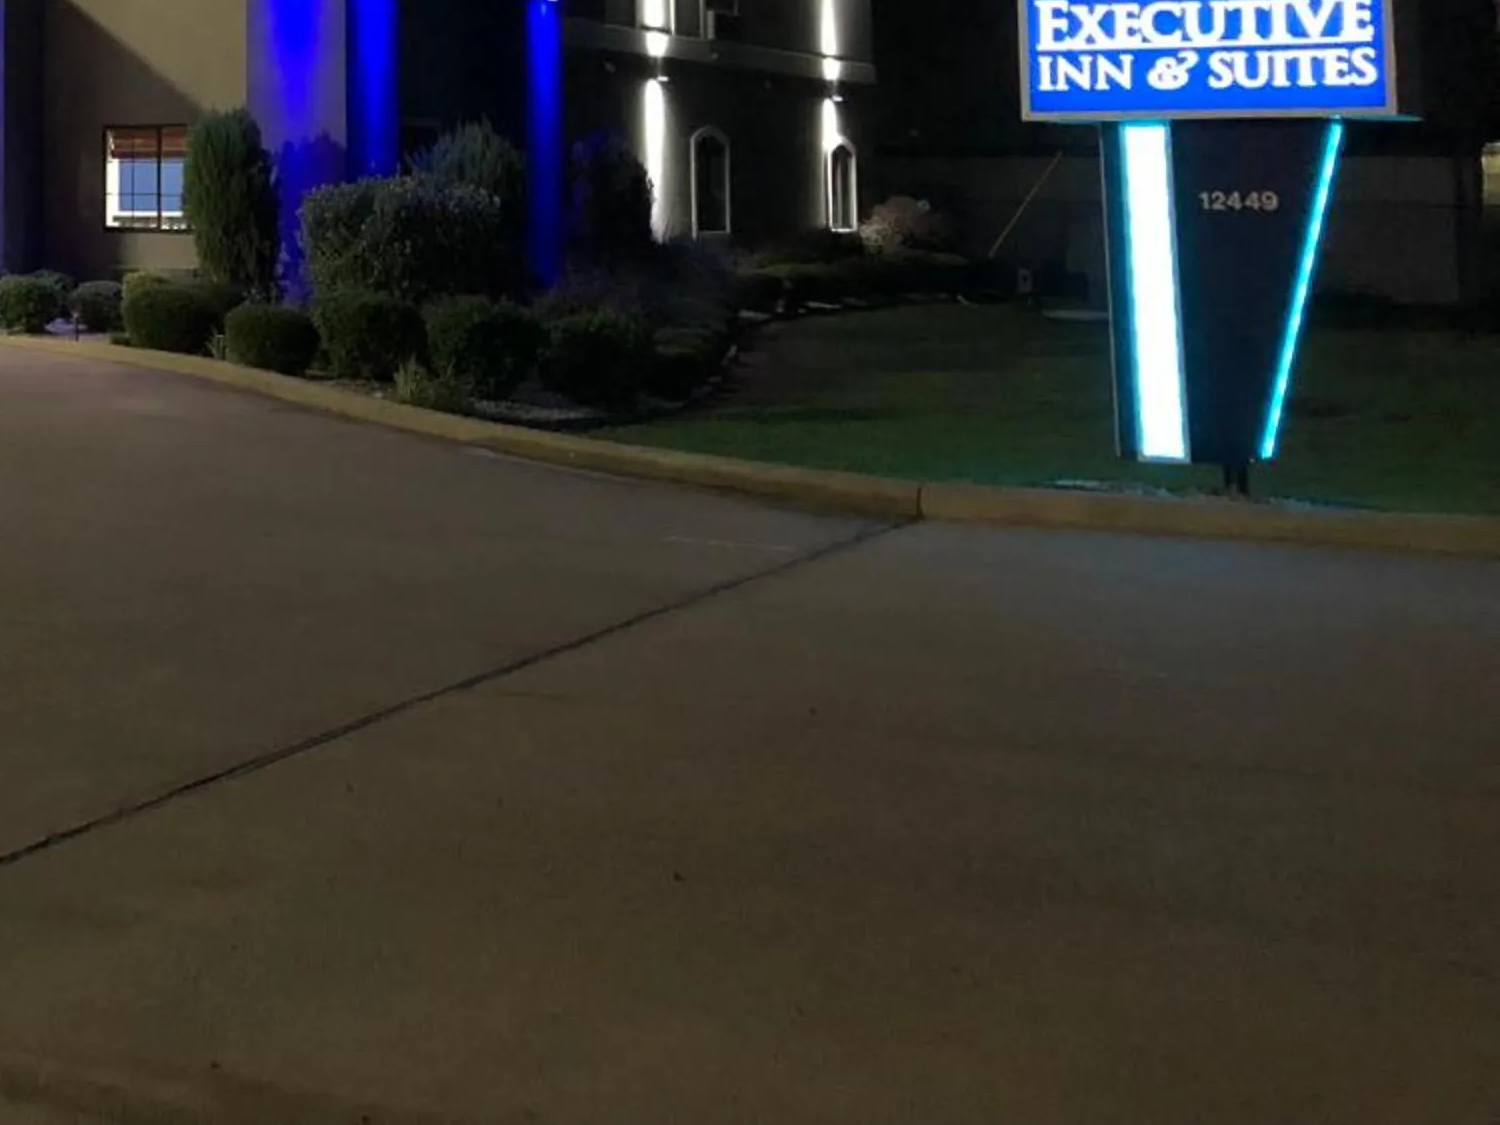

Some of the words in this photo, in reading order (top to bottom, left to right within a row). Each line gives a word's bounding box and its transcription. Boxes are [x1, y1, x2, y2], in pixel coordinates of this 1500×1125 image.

[1038, 54, 1133, 91] INN
[1147, 49, 1199, 89] &
[1208, 47, 1378, 88] SUITES
[1199, 190, 1279, 211] 12449
